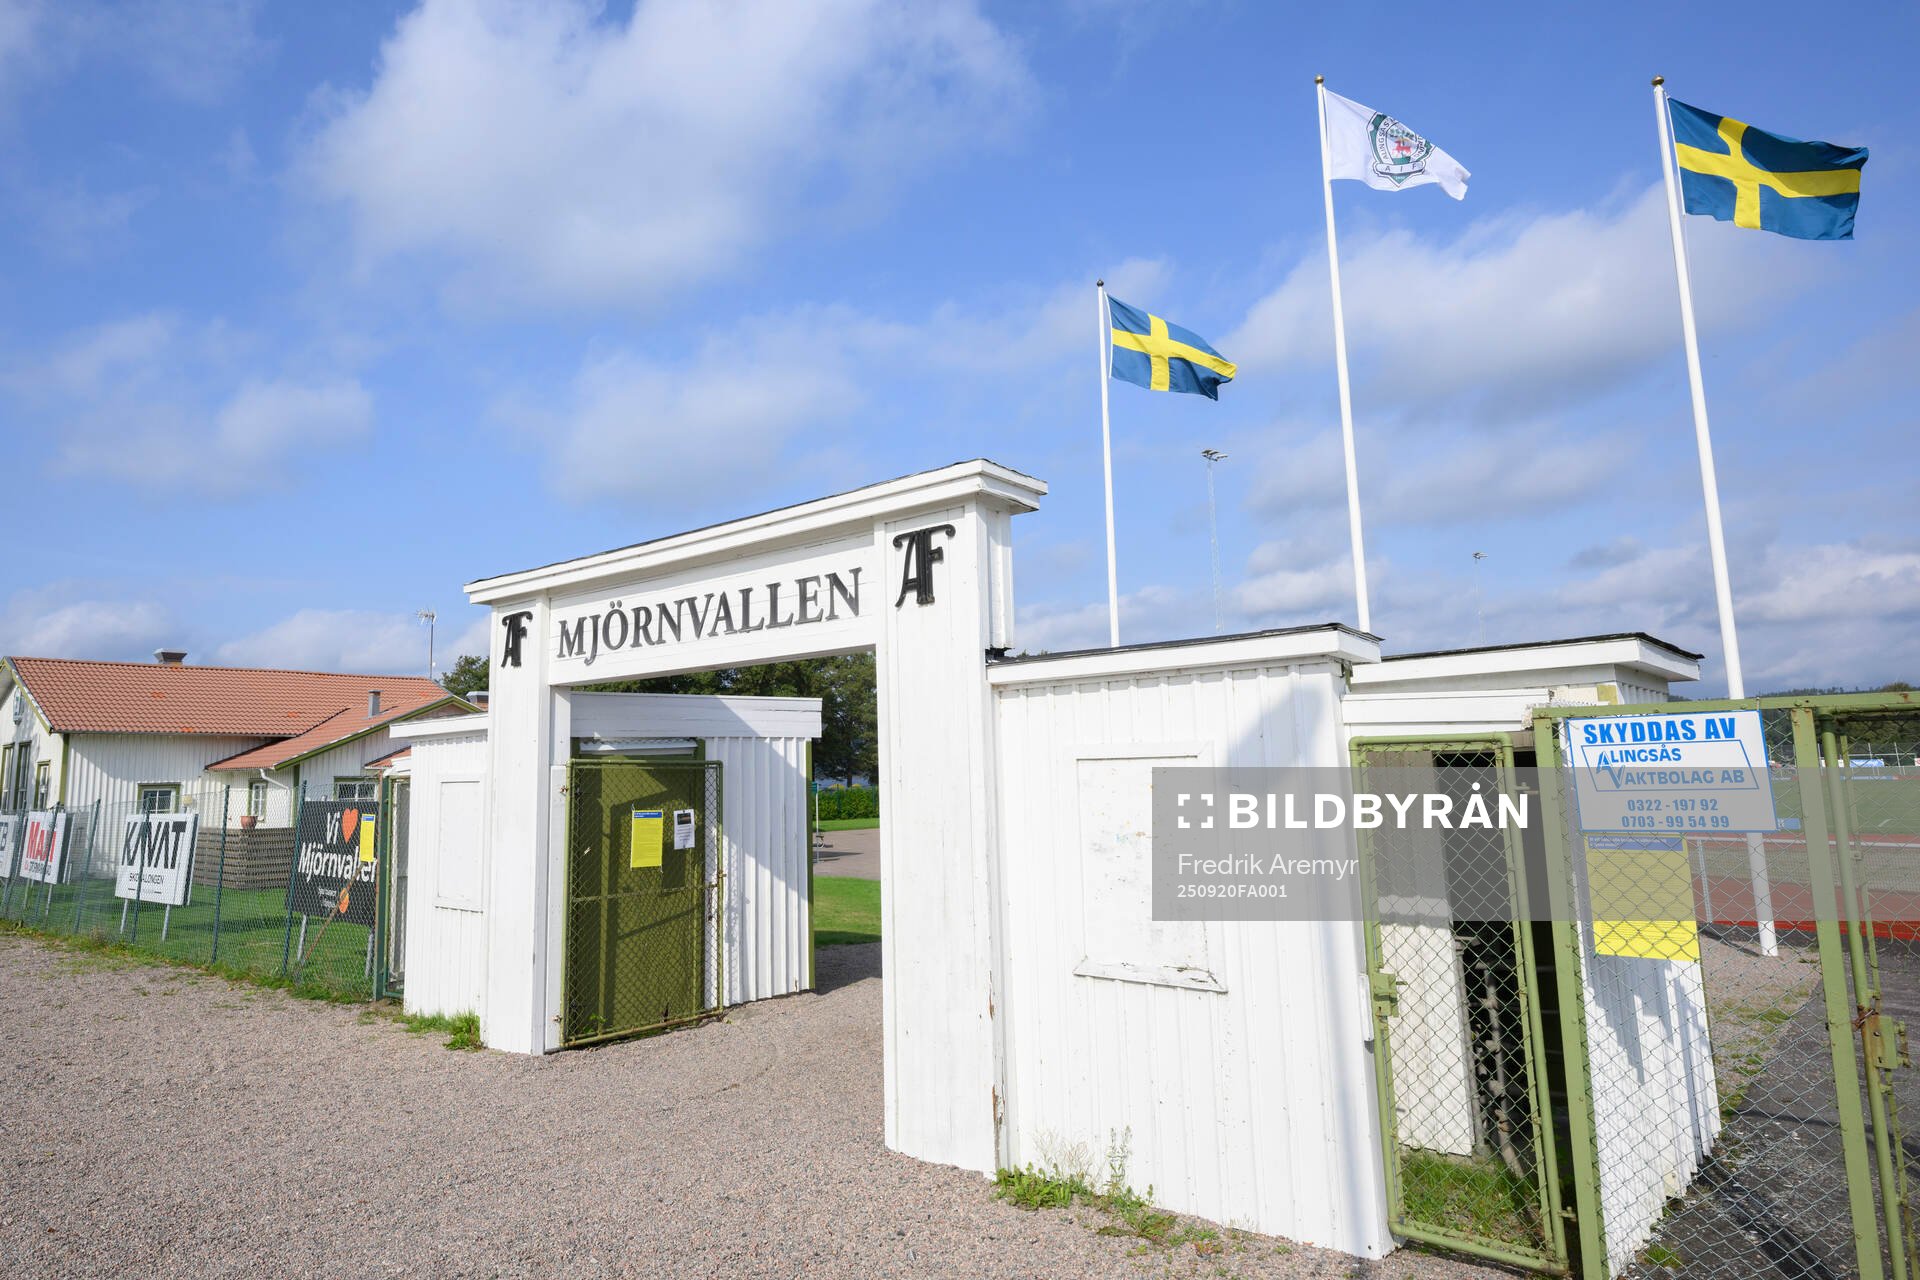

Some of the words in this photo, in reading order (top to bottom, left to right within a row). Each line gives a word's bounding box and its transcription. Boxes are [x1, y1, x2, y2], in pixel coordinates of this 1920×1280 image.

[558, 567, 862, 665] MJÖRNVALLEN
[1584, 719, 1697, 744] SKYDDAS
[1705, 718, 1736, 739] AV
[1596, 744, 1682, 774] ALINGSÅS
[1605, 764, 1714, 789] VAKTBOLAG
[1720, 769, 1745, 784] AB
[1627, 799, 1662, 812] 0322
[1672, 799, 1696, 812] 197
[1700, 798, 1718, 811] 92
[326, 811, 340, 844] Vi
[1621, 815, 1655, 828] 0703
[1666, 815, 1684, 828] 99
[1688, 815, 1707, 828] 54
[1711, 815, 1730, 828] 99
[122, 821, 188, 870] KAVAT
